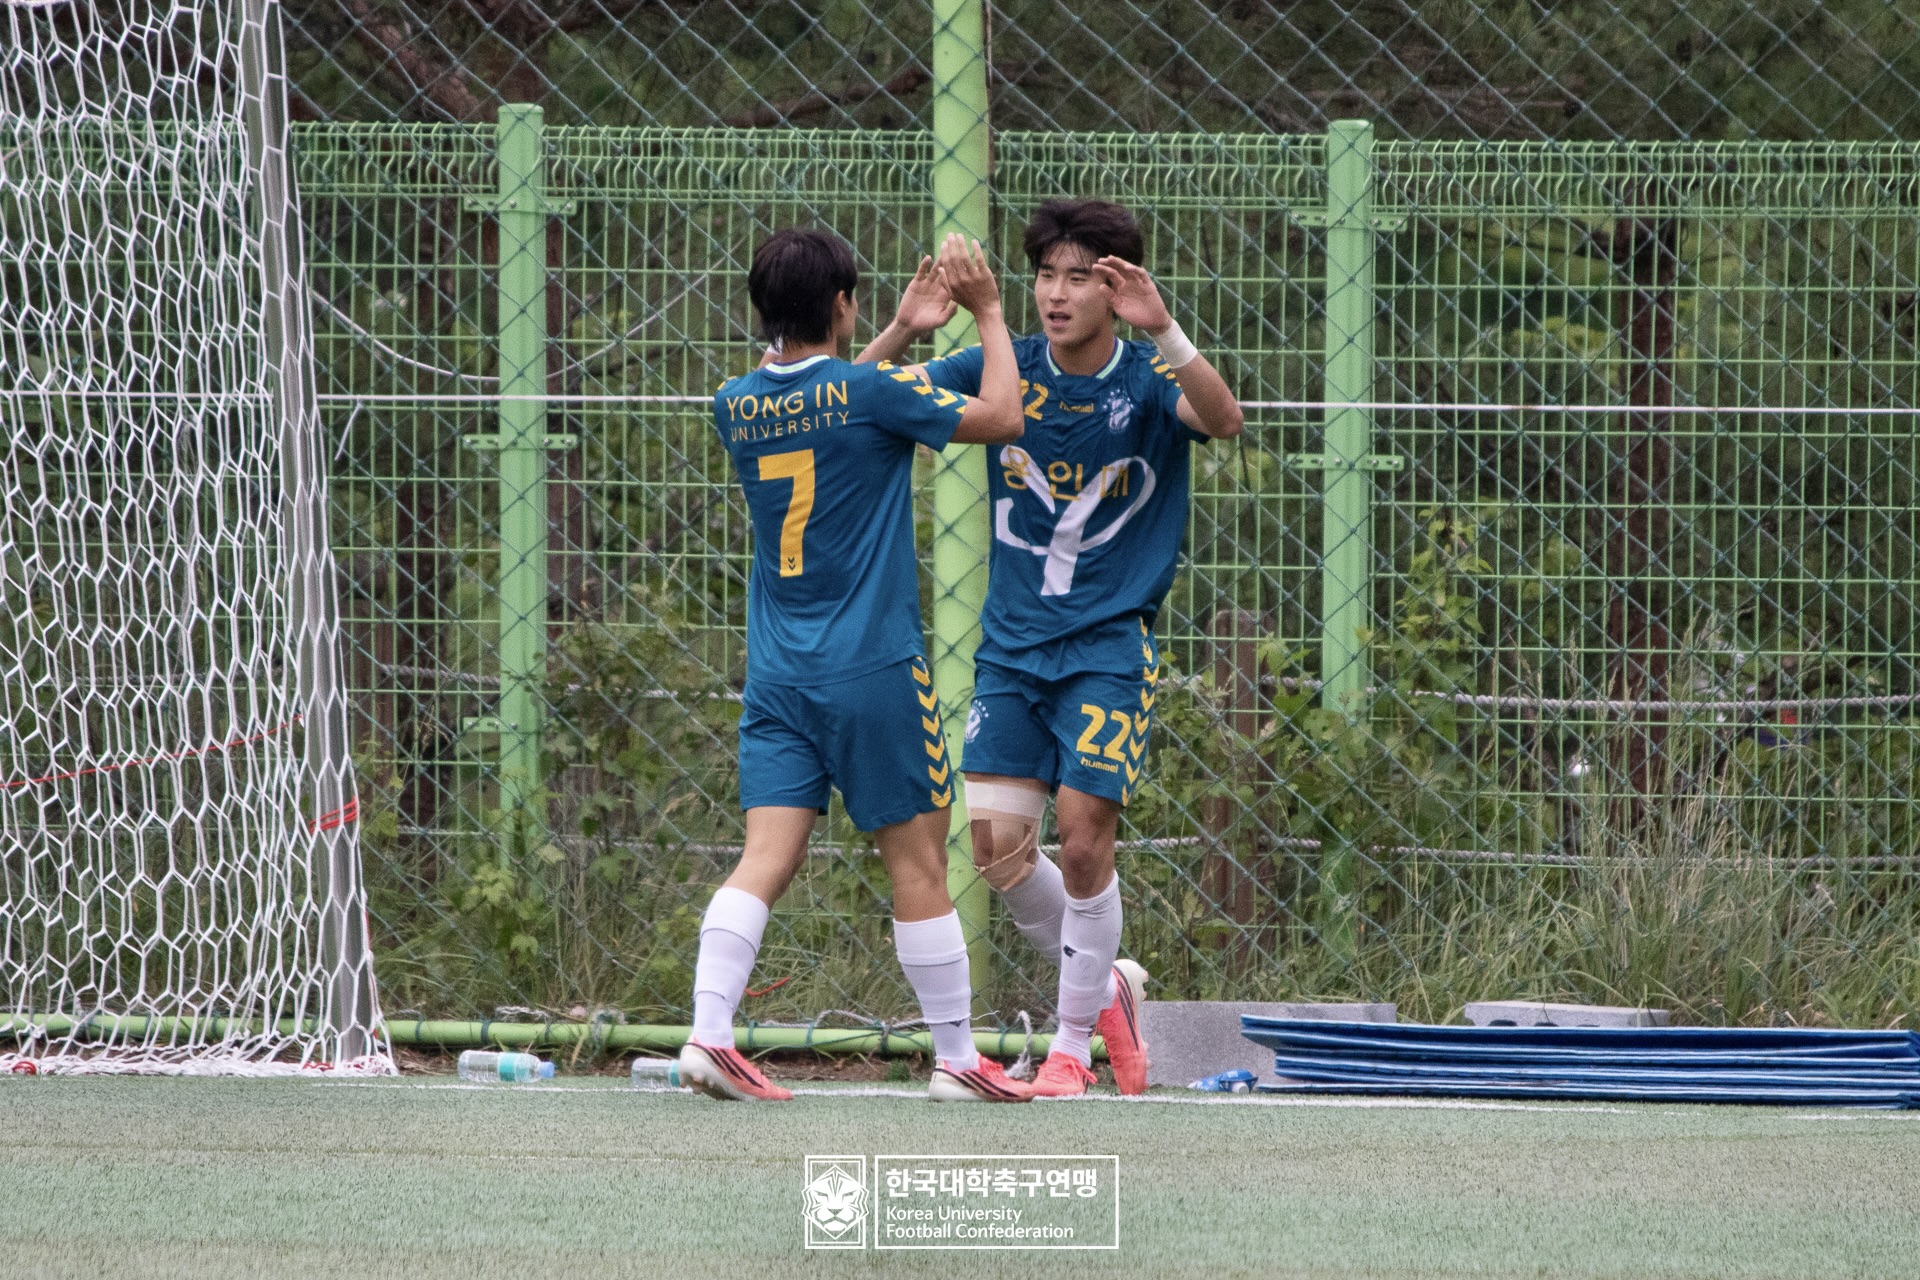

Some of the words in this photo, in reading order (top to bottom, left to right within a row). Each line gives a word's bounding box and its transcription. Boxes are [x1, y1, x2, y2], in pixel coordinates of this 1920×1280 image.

[726, 391, 805, 422] YONG
[815, 380, 848, 408] IN
[730, 410, 849, 442] UNIVERSITY
[757, 448, 816, 577] 7
[1076, 703, 1132, 763] 22
[1080, 756, 1119, 774] hummel
